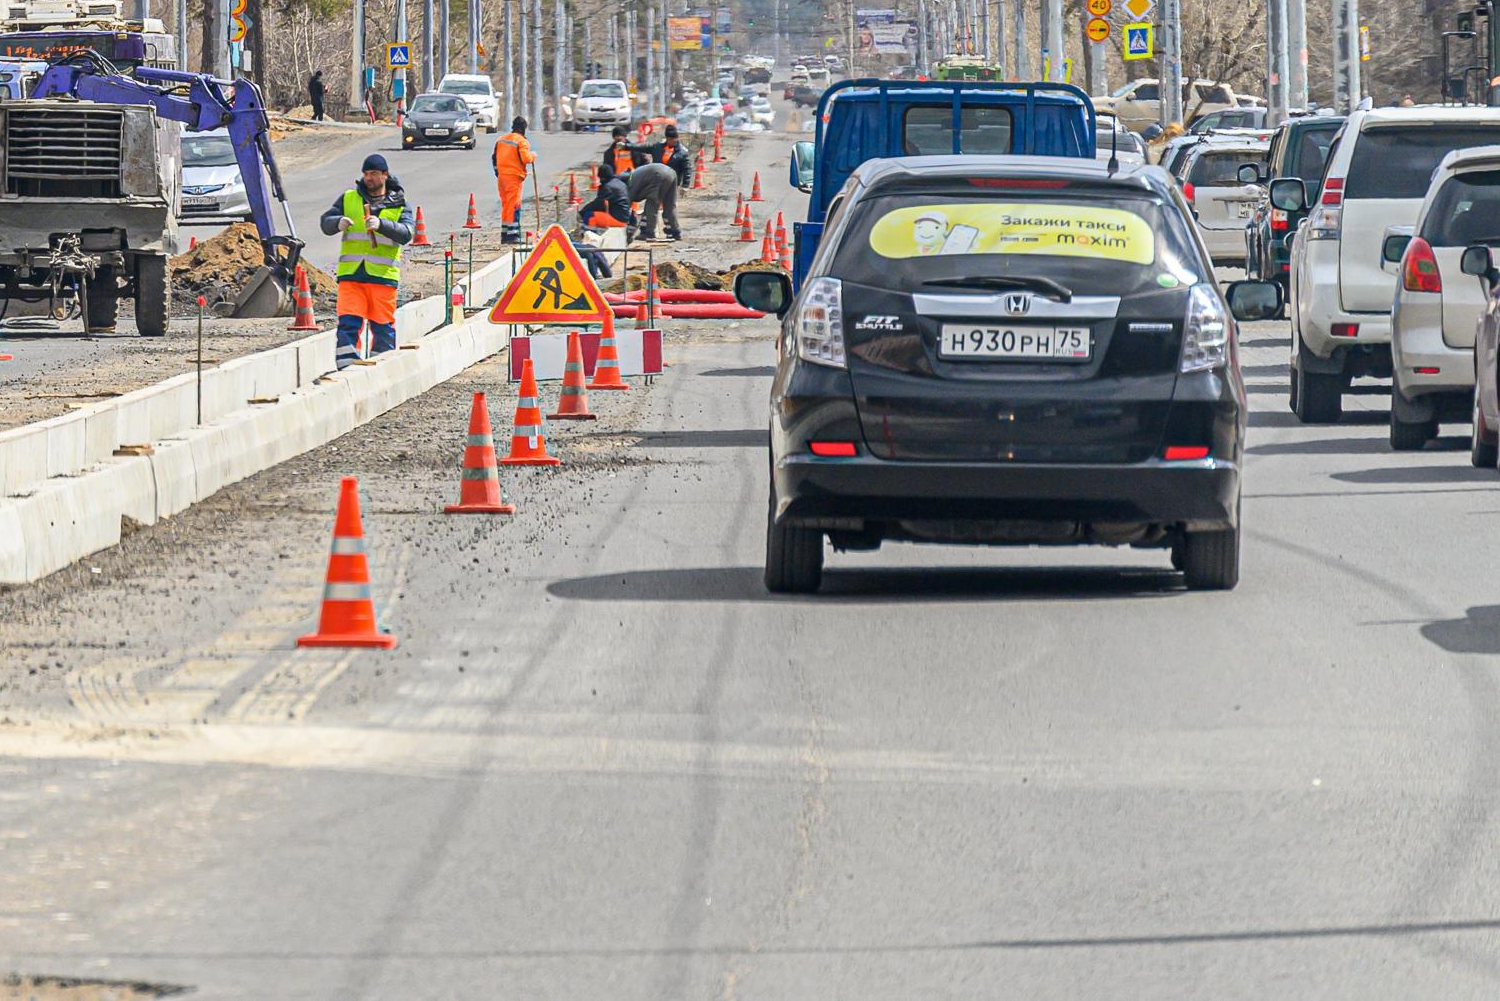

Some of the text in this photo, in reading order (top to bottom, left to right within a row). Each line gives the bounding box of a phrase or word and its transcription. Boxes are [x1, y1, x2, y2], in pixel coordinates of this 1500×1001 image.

[1091, 0, 1107, 10] 40
[1001, 214, 1126, 232] Закажи такси
[1057, 233, 1127, 248] maxim
[1058, 330, 1082, 348] 75
